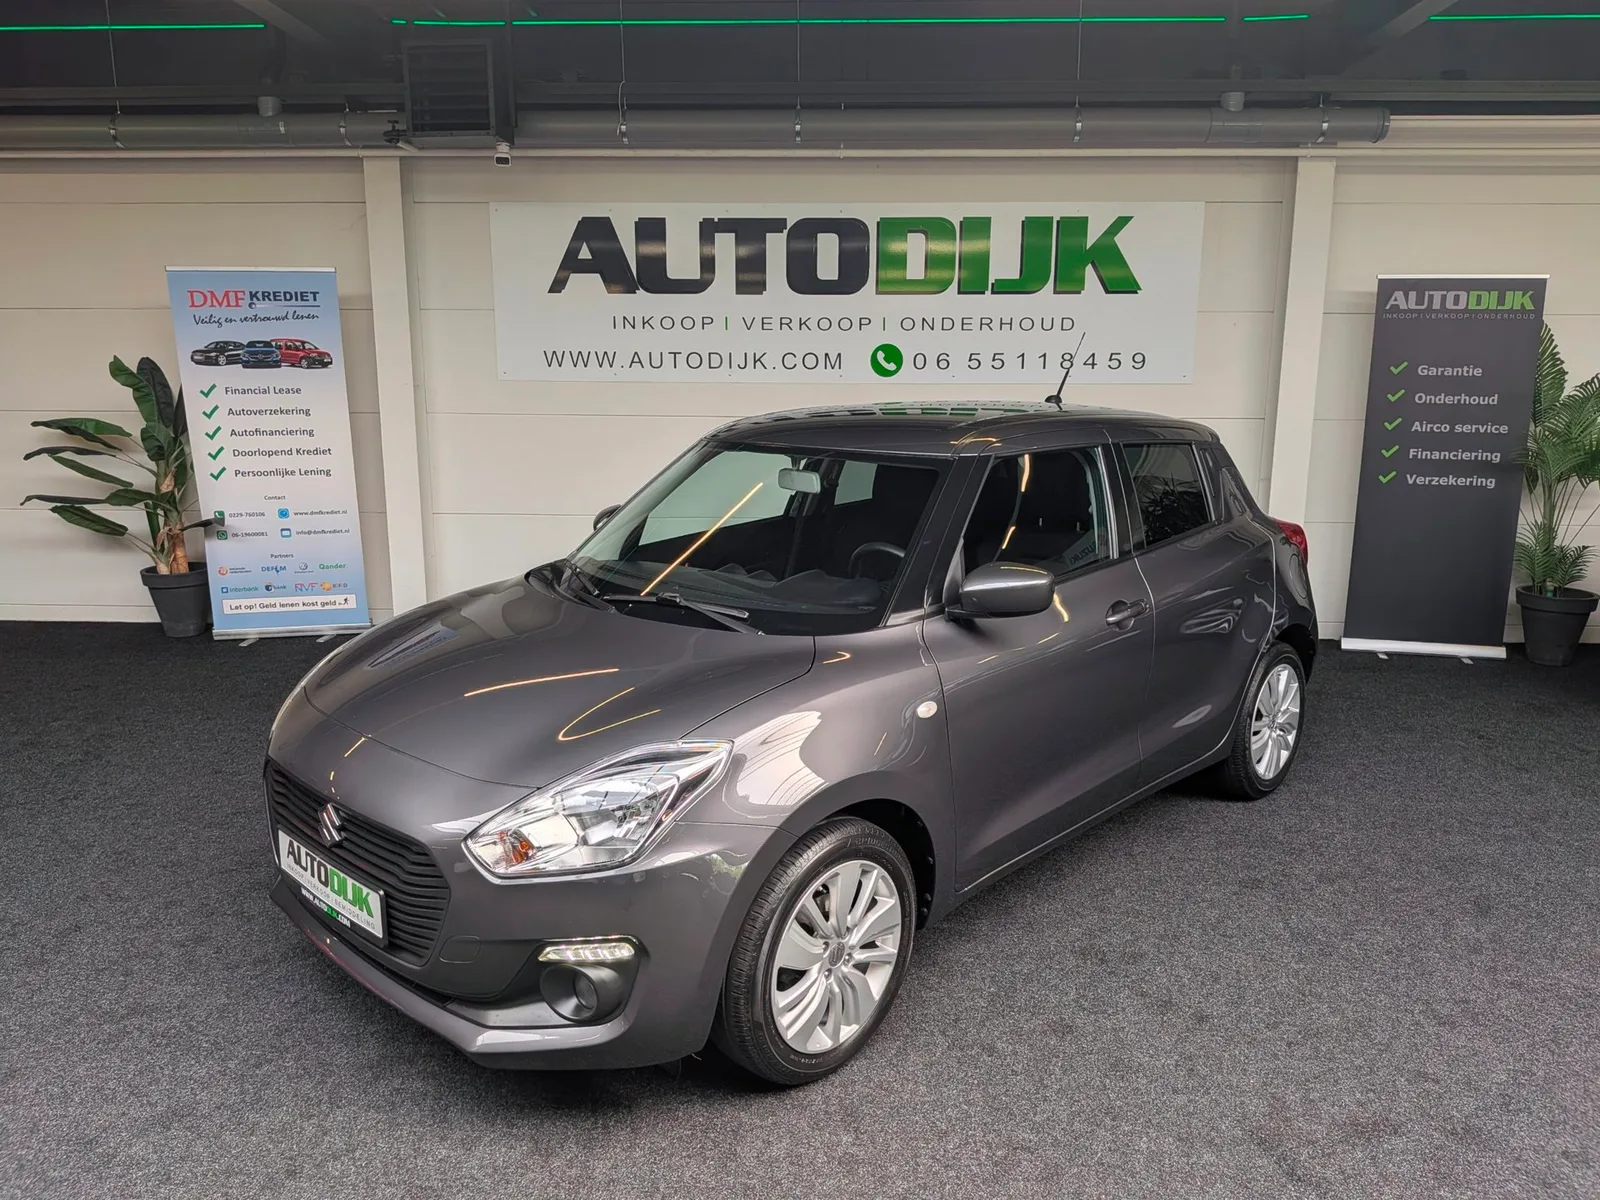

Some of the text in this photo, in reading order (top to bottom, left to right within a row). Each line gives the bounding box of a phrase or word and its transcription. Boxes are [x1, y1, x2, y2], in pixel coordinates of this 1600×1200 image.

[548, 216, 1142, 294] AUTODIJK
[188, 290, 320, 308] DMF KREDIET
[1384, 290, 1535, 310] AUTODIJK
[192, 314, 223, 328] Veilig
[239, 313, 290, 322] vertrouwd
[292, 311, 320, 320] lenen
[612, 316, 714, 330] INKOOP
[742, 316, 872, 331] VERKOOP
[900, 316, 1076, 331] ONDERHOUD
[543, 350, 842, 370] WWW.AUTODIJK.COM
[913, 352, 951, 370] 06
[1418, 365, 1482, 376] Garantie
[224, 386, 302, 395] Financial Lease
[1415, 393, 1498, 405] Onderhoud
[227, 406, 312, 417] Autoverzekering
[230, 428, 315, 438] Autofinanciering
[1411, 421, 1508, 434] Airco service
[232, 447, 332, 458] Doorlopend Krediet
[1409, 449, 1500, 463] Financiering
[234, 468, 332, 479] Persoonlijke Lening
[1407, 475, 1496, 488] Verzekering
[244, 603, 257, 611] op!
[287, 839, 374, 918] AUTODIJK
